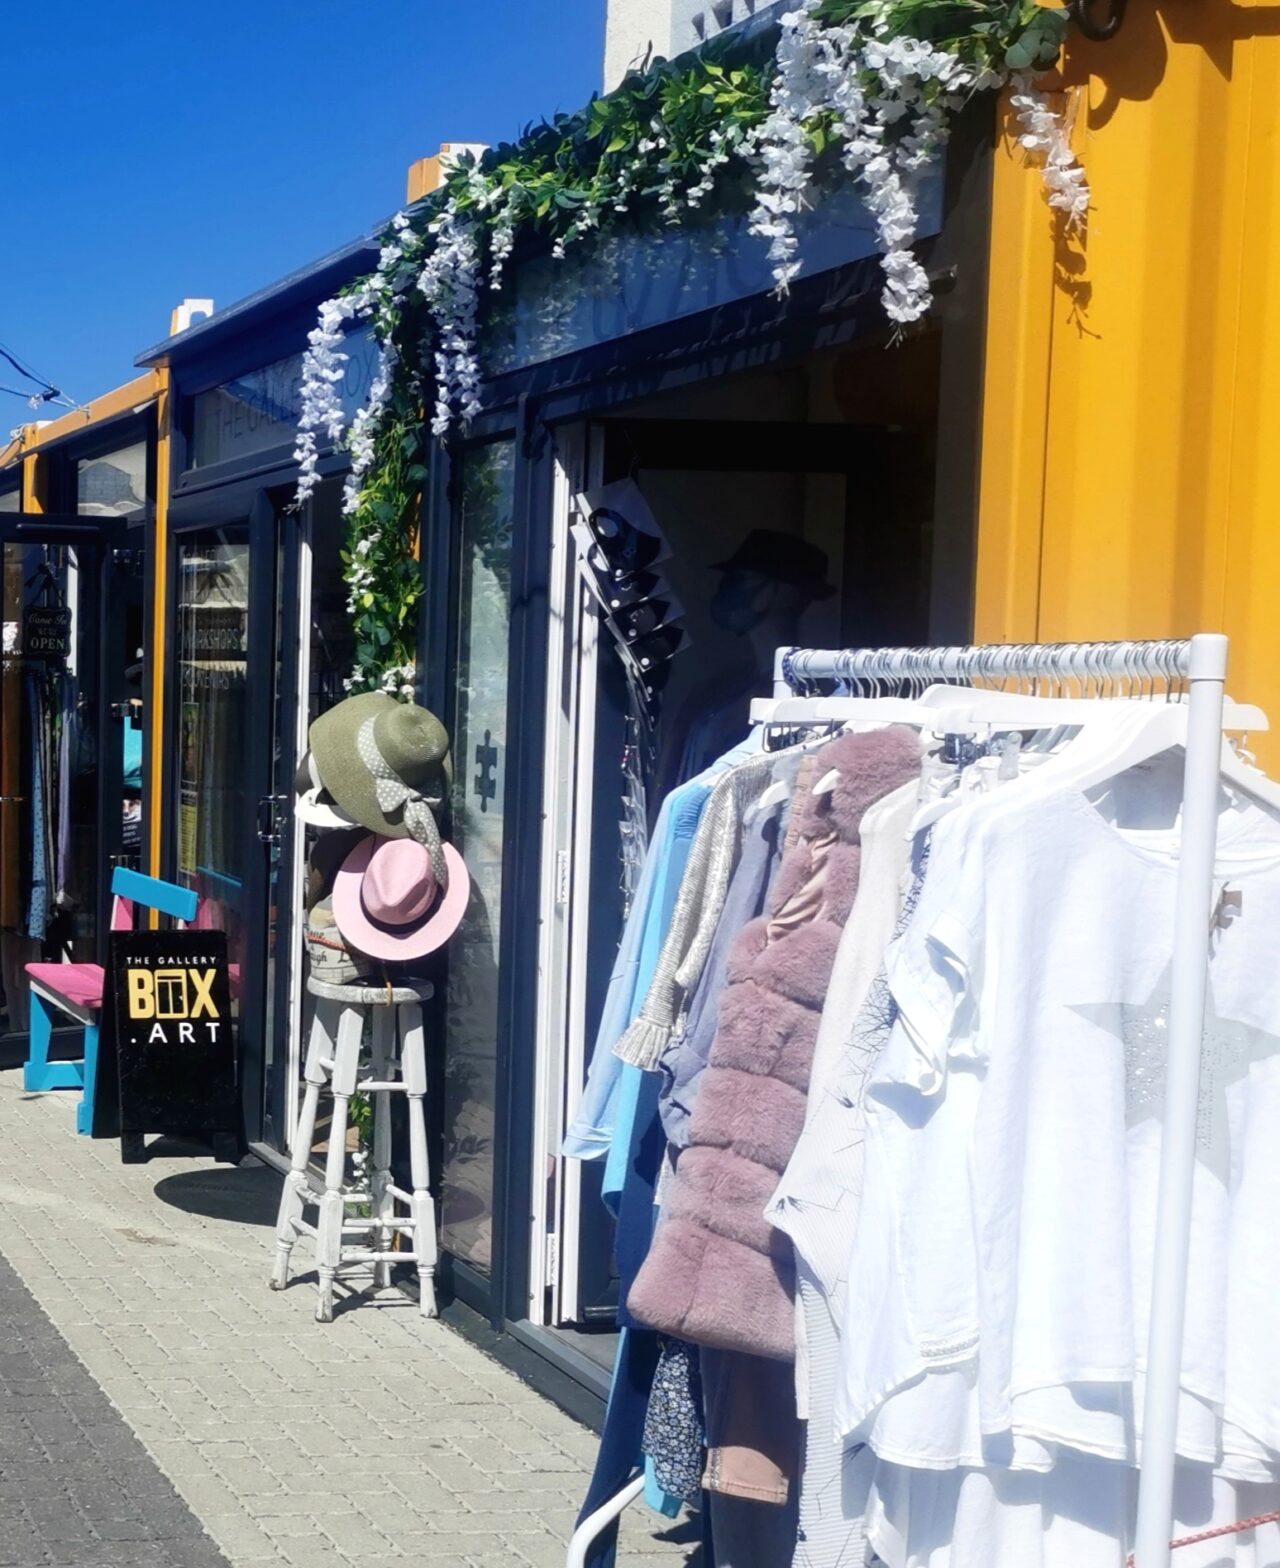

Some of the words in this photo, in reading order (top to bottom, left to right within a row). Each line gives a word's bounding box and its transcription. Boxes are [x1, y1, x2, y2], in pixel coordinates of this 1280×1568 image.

[30, 636, 65, 650] OPEN
[126, 956, 150, 965] THE
[157, 956, 217, 965] GALLERY
[127, 968, 220, 1019] BOX
